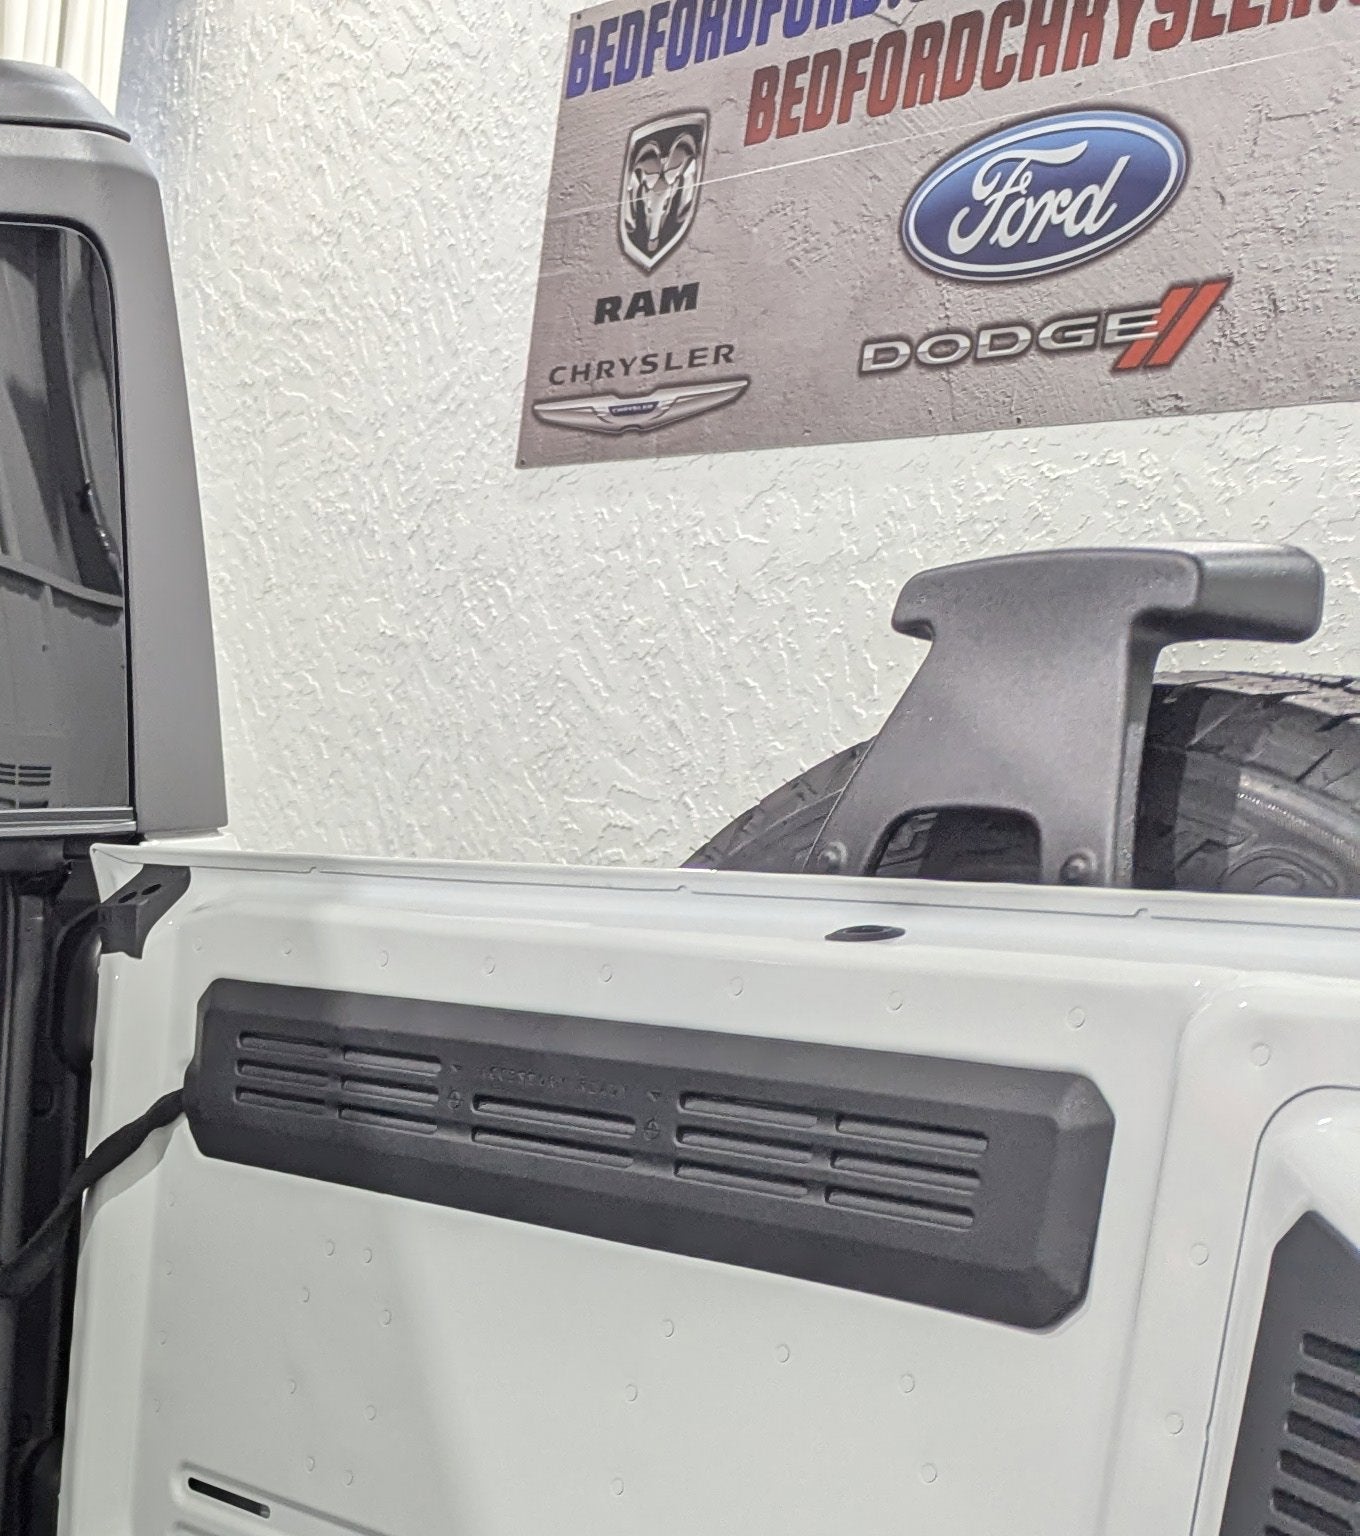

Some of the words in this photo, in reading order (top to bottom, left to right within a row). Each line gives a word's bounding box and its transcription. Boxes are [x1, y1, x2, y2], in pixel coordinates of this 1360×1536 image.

[948, 140, 1131, 254] Ford
[594, 282, 700, 325] RAM
[549, 344, 735, 386] CHRYSLER
[860, 306, 1162, 374] DODGE
